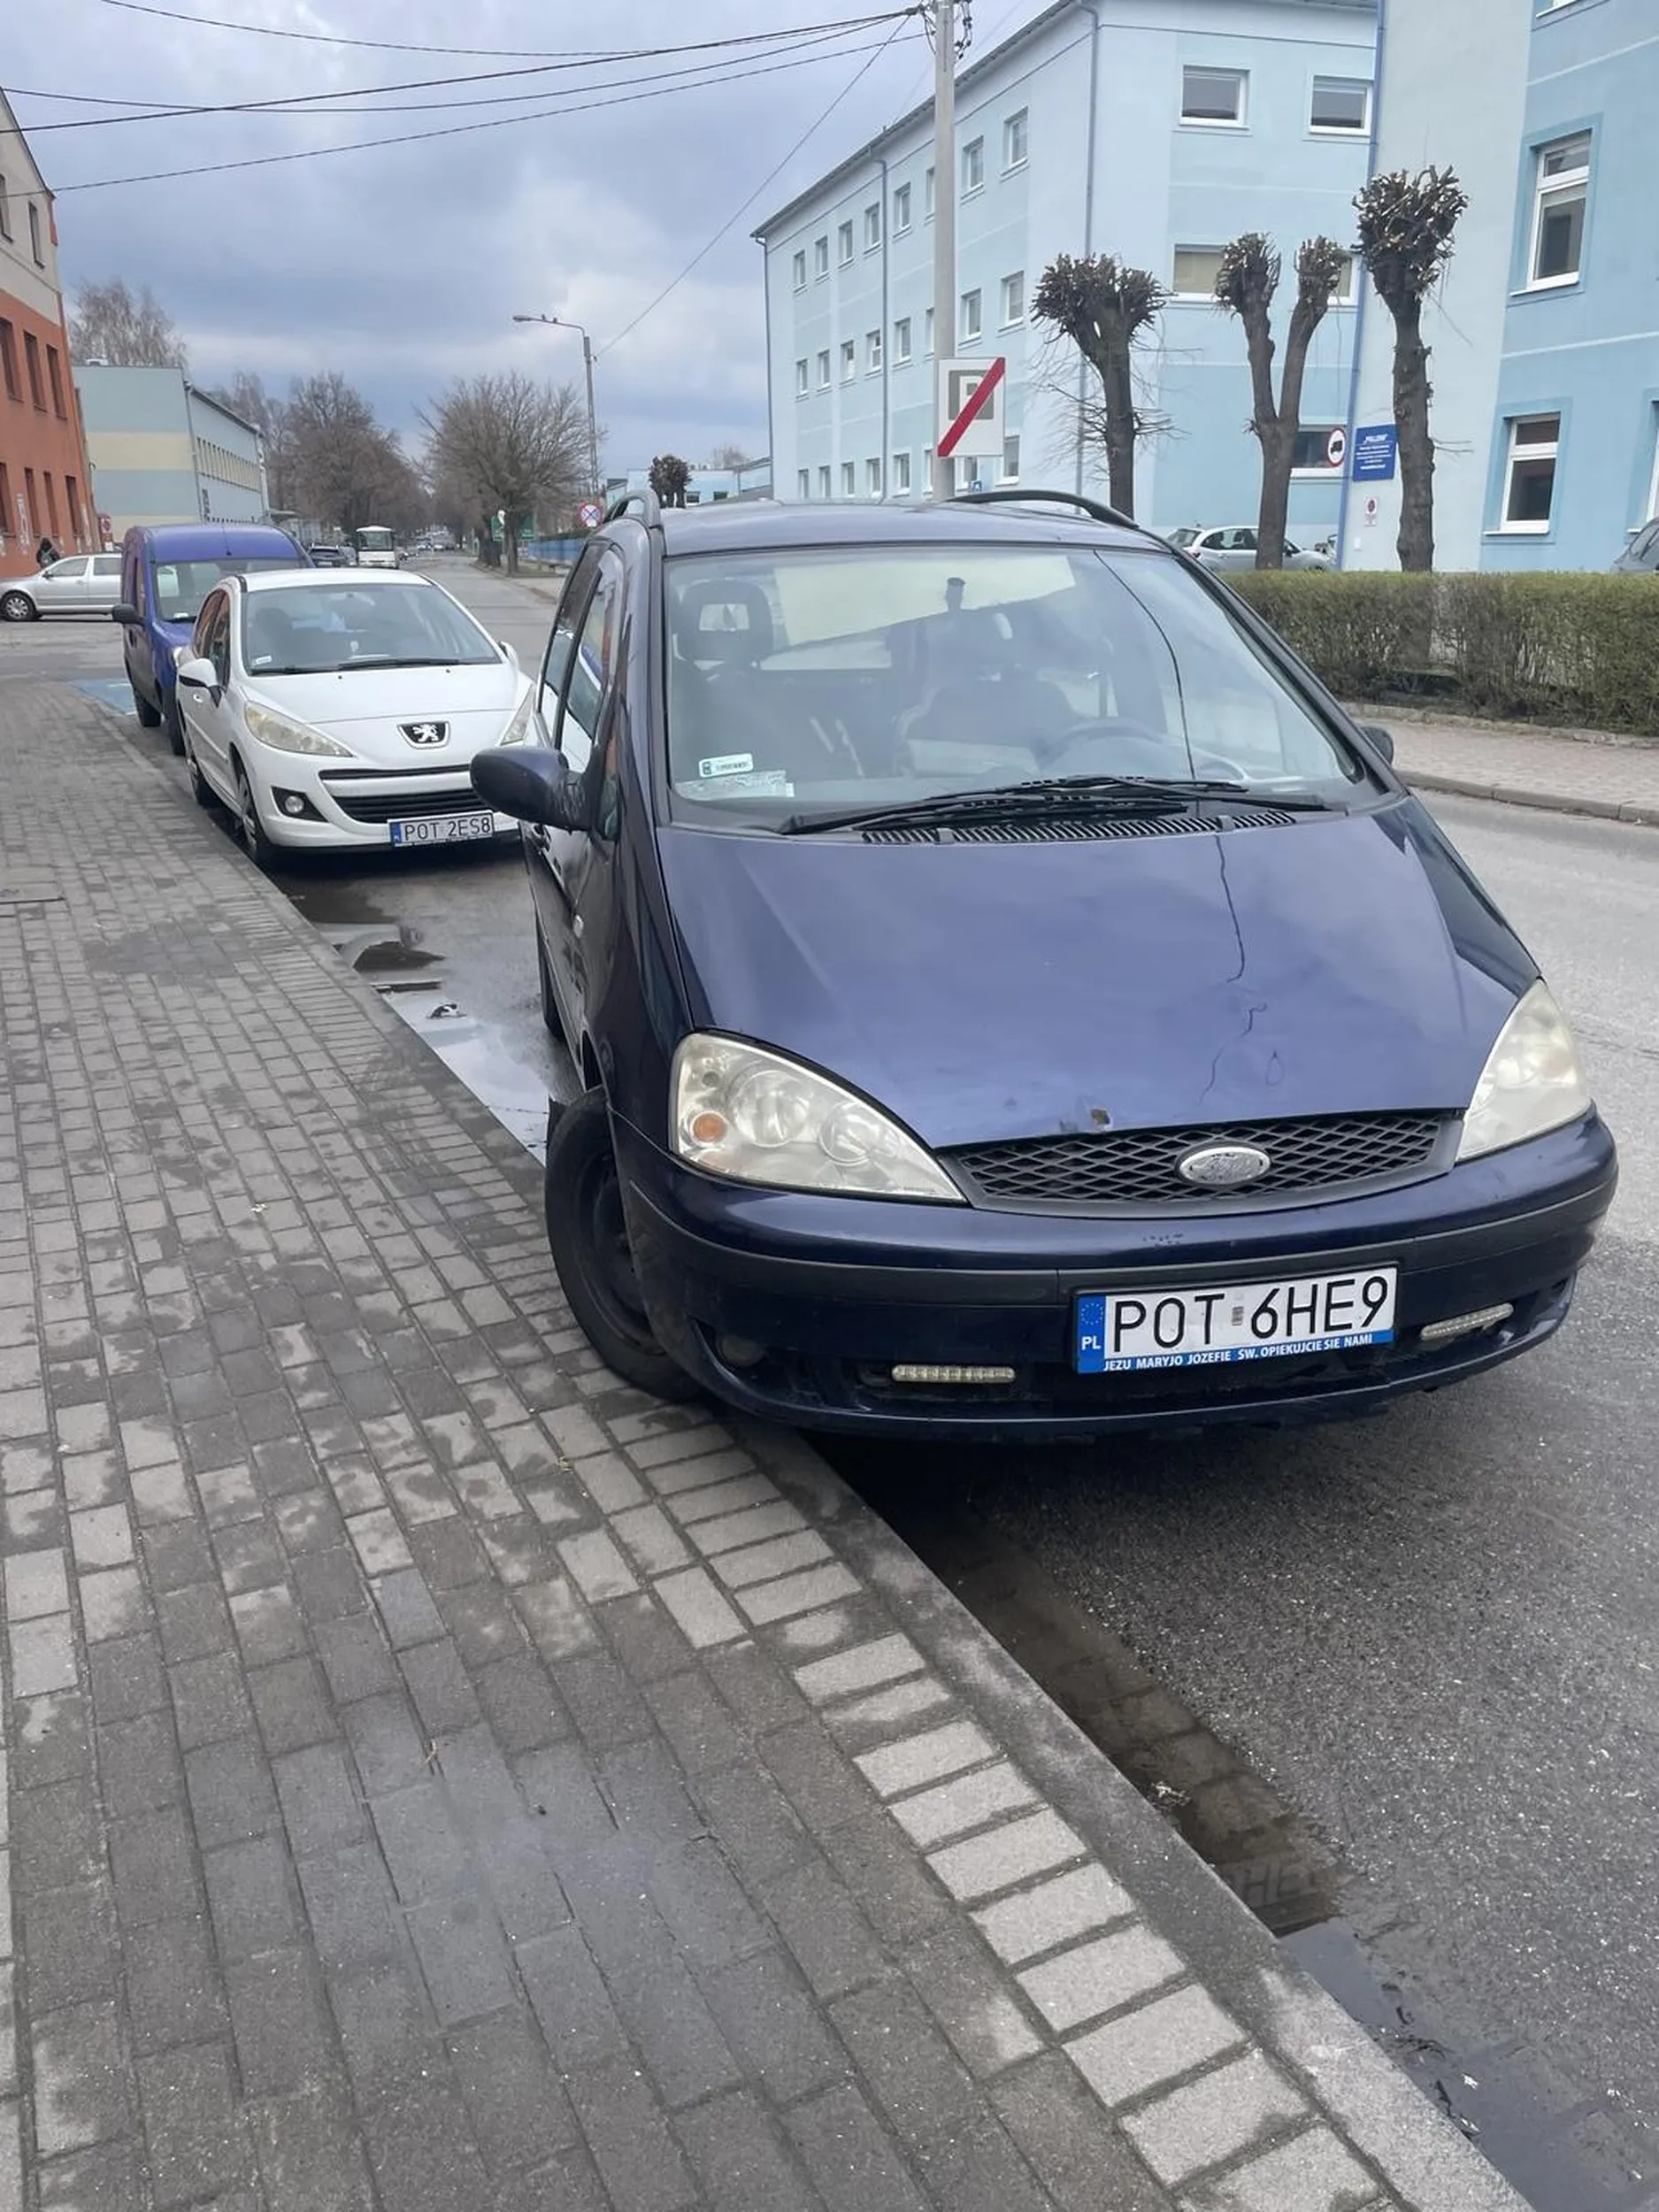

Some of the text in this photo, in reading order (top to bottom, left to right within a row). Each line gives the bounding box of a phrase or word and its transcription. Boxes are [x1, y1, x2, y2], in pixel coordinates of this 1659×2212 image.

[404, 822, 439, 841] POT
[448, 817, 491, 837] 2ES8
[1113, 1275, 1388, 1353] POT 6HE9
[1081, 1336, 1102, 1351] PL
[1103, 1359, 1132, 1371] JEZU
[1136, 1356, 1183, 1370] MARYJO
[1187, 1350, 1232, 1364] JOZEFIE
[1260, 1338, 1323, 1356] OPIEKUJCIE
[1344, 1333, 1373, 1348] NAMI
